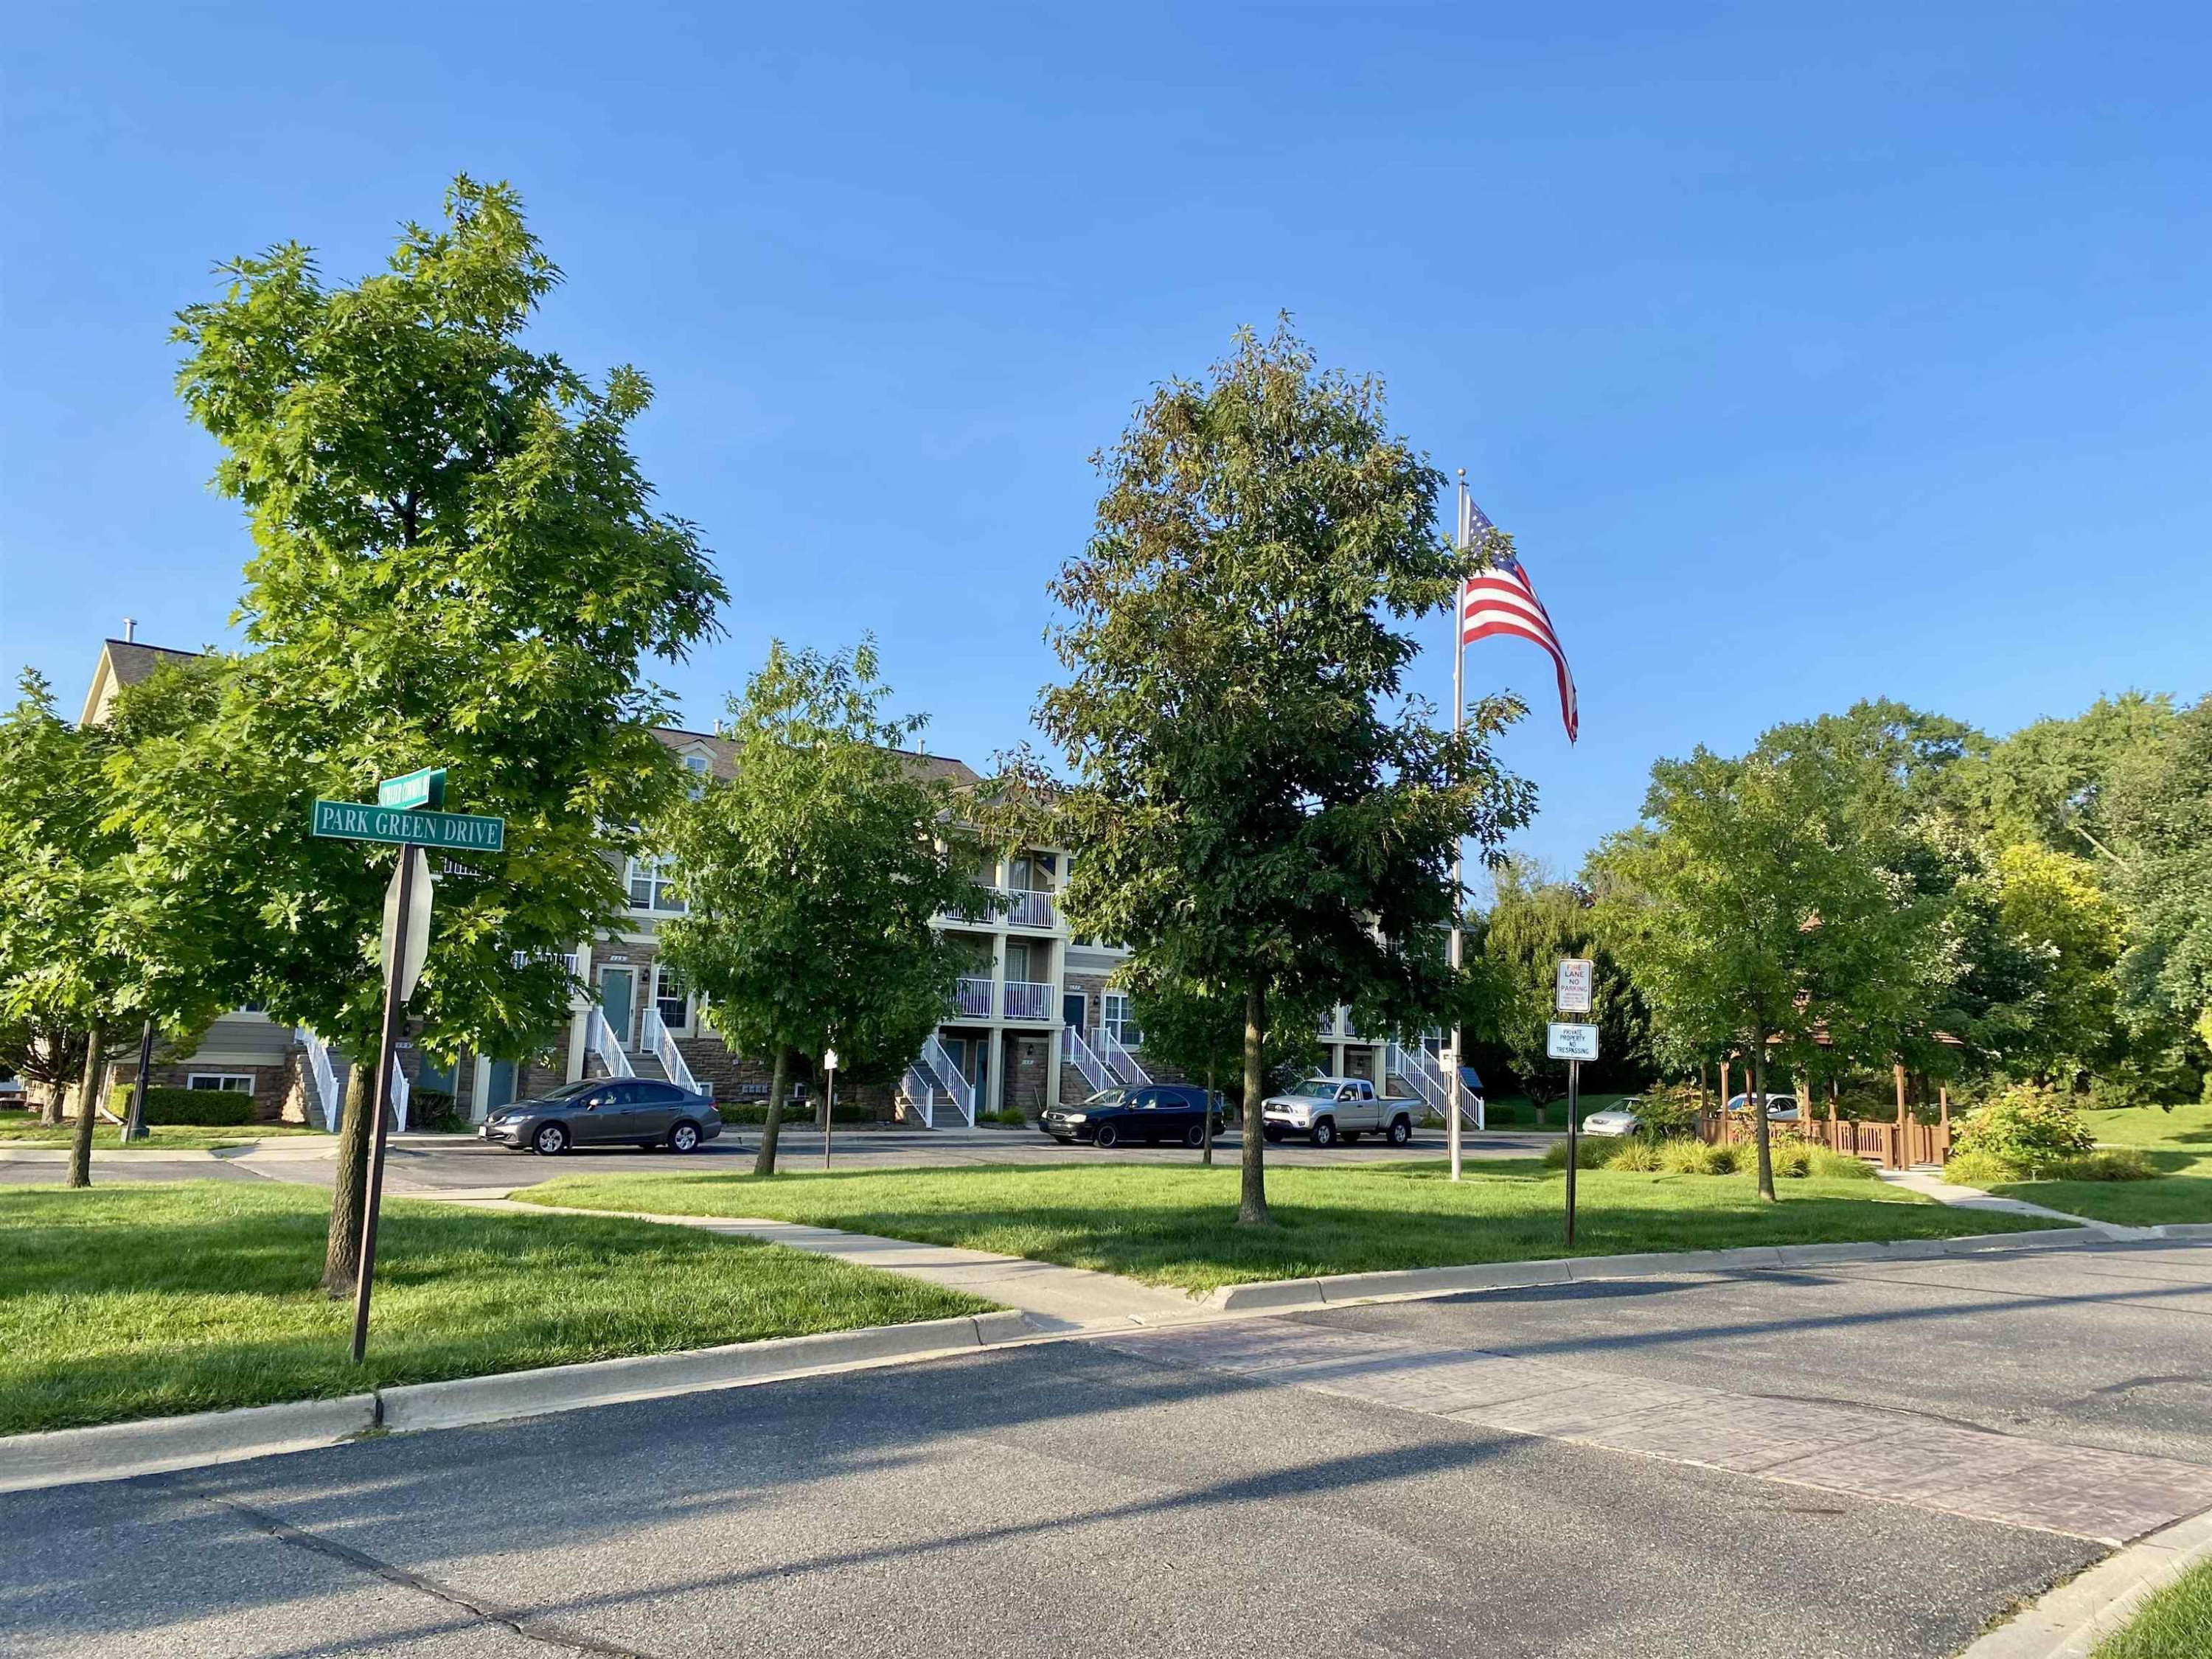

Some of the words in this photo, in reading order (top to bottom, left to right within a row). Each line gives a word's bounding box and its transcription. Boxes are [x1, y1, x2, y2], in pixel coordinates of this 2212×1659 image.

[321, 807, 369, 833] PARK
[375, 813, 437, 839] GREEN
[443, 819, 498, 844] DRIVE
[1557, 1046, 1589, 1055] TRESPASSING
